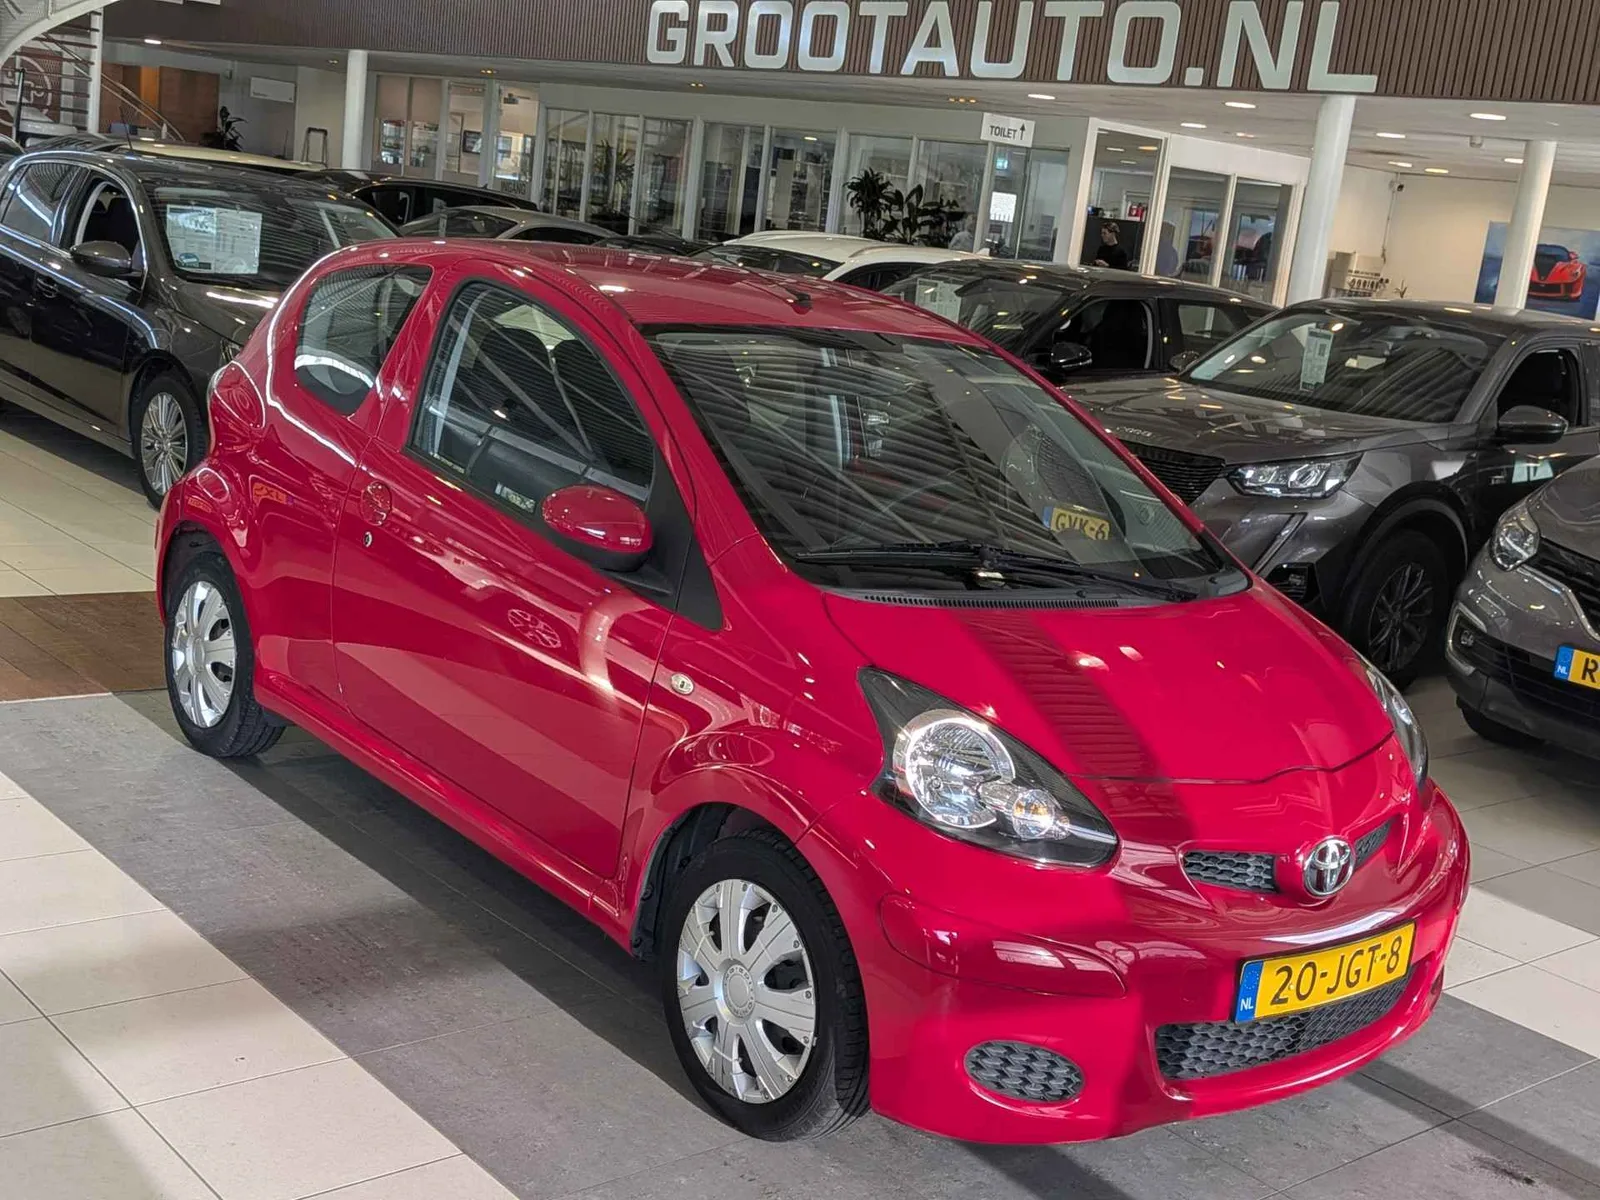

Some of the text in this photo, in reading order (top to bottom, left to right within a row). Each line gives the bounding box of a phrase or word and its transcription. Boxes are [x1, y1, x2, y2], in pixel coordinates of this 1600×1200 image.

[646, 0, 1378, 93] GROOTAUTO.NL
[989, 124, 1018, 140] TOILET
[1557, 665, 1568, 675] NL
[1269, 935, 1403, 1006] 20-JGT-8
[1240, 997, 1254, 1011] NL
